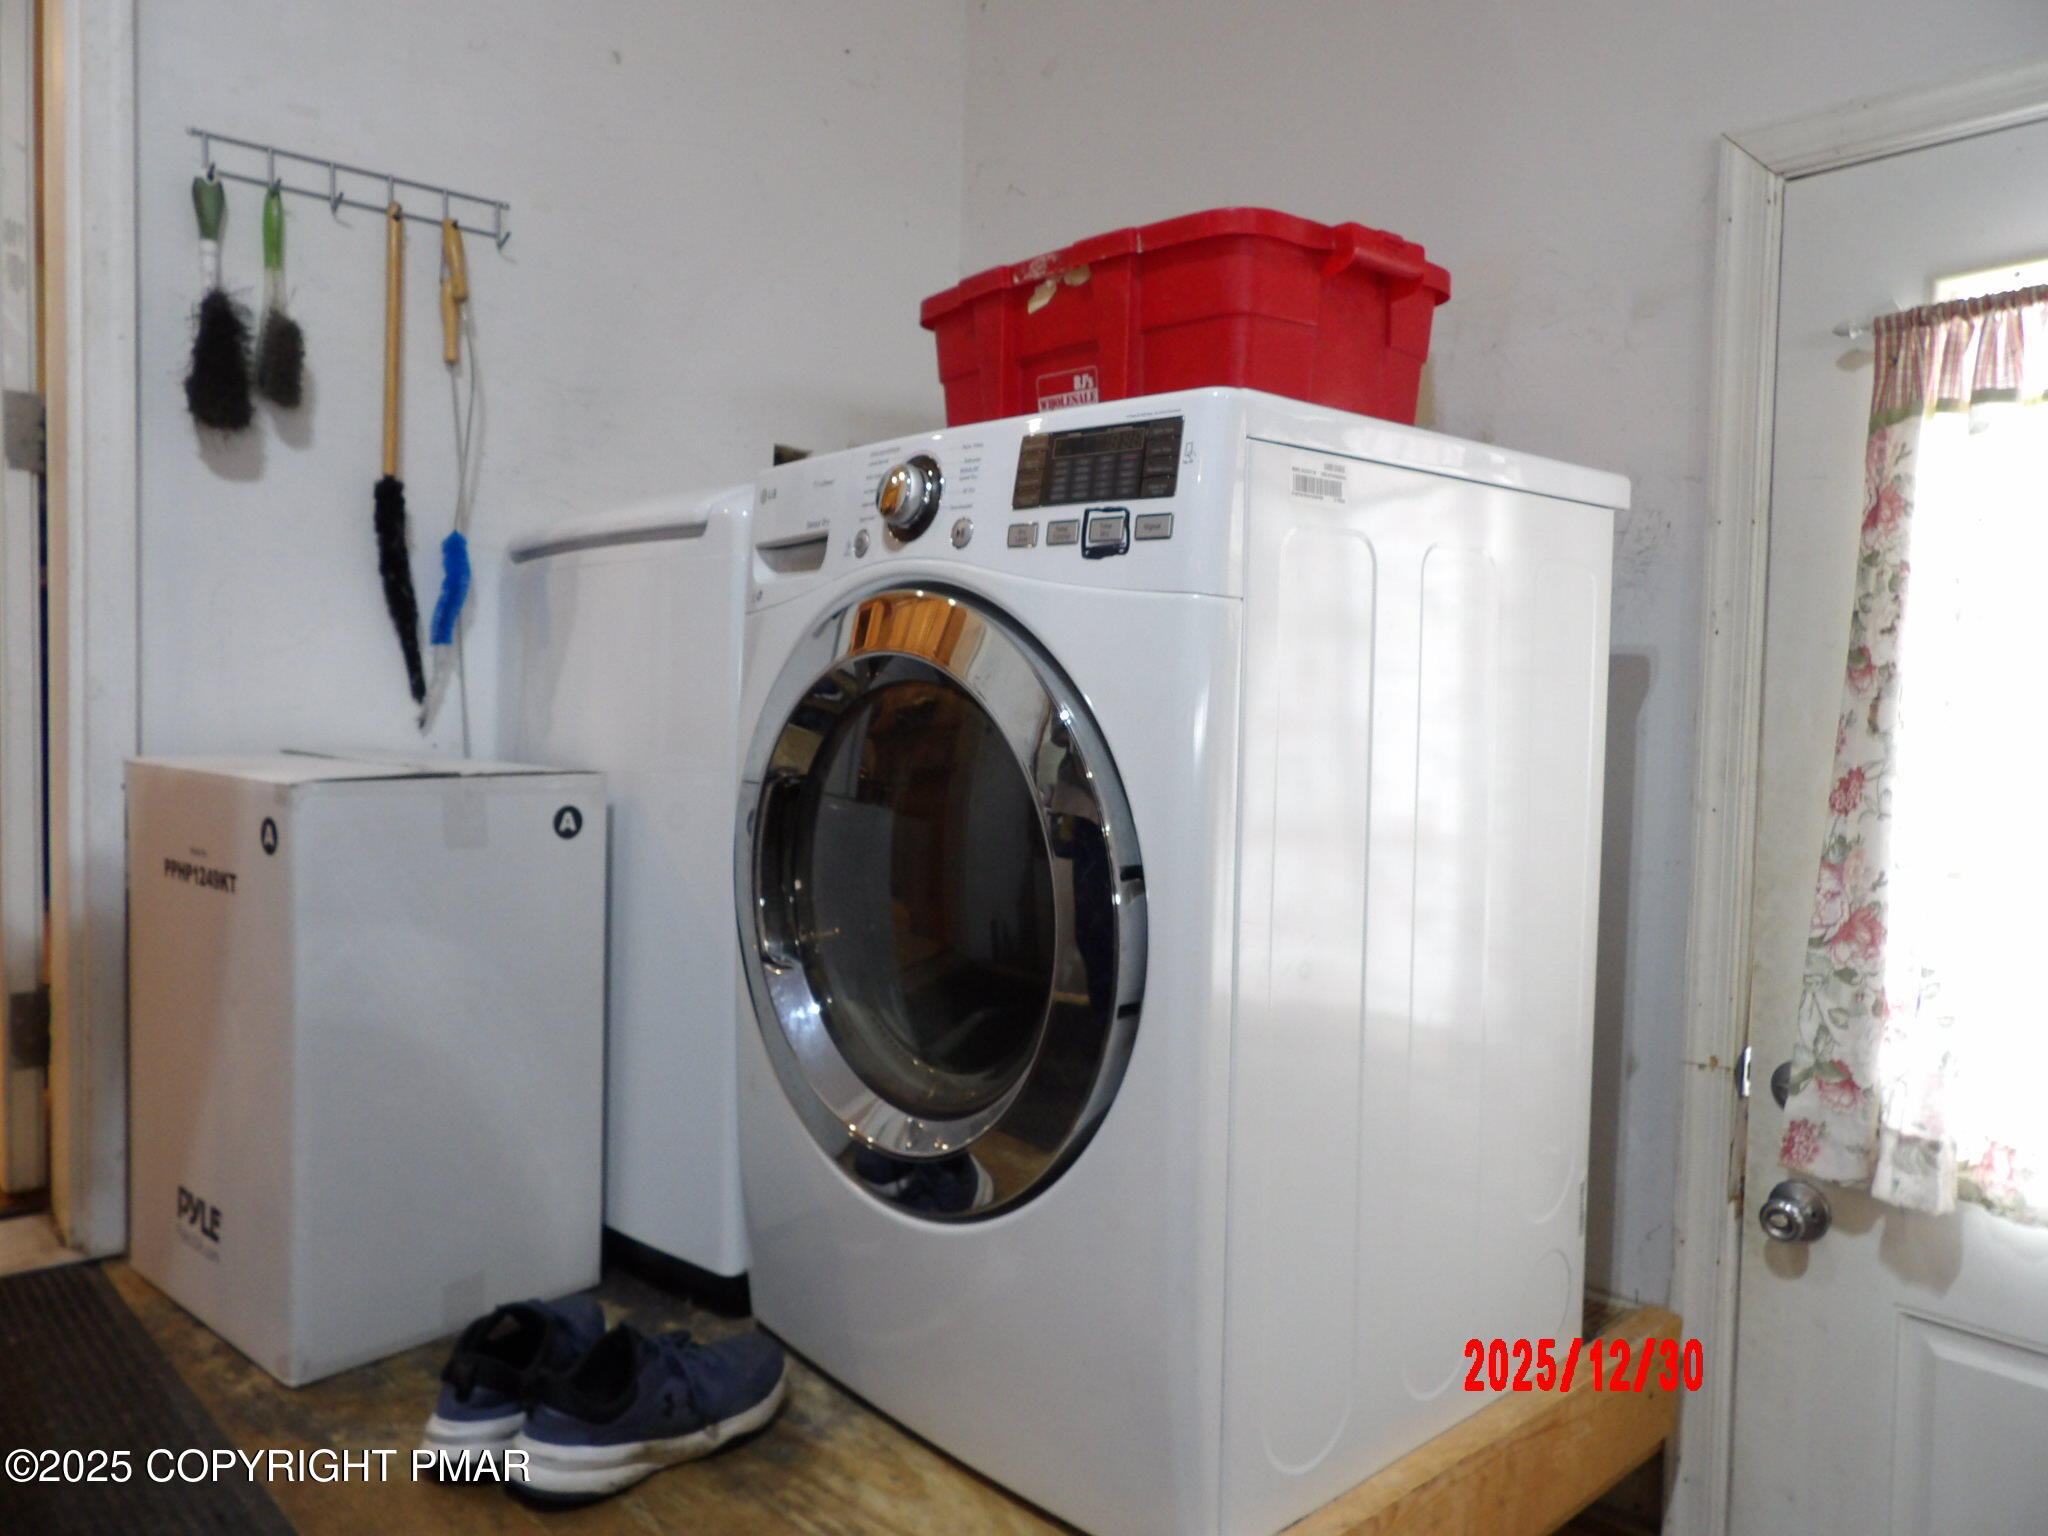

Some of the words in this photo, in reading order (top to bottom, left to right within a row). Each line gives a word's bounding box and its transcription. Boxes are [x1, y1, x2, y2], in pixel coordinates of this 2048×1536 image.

[1073, 373, 1095, 391] BJ's
[1038, 388, 1098, 411] WHOLESALE
[177, 1184, 222, 1243] PYLE
